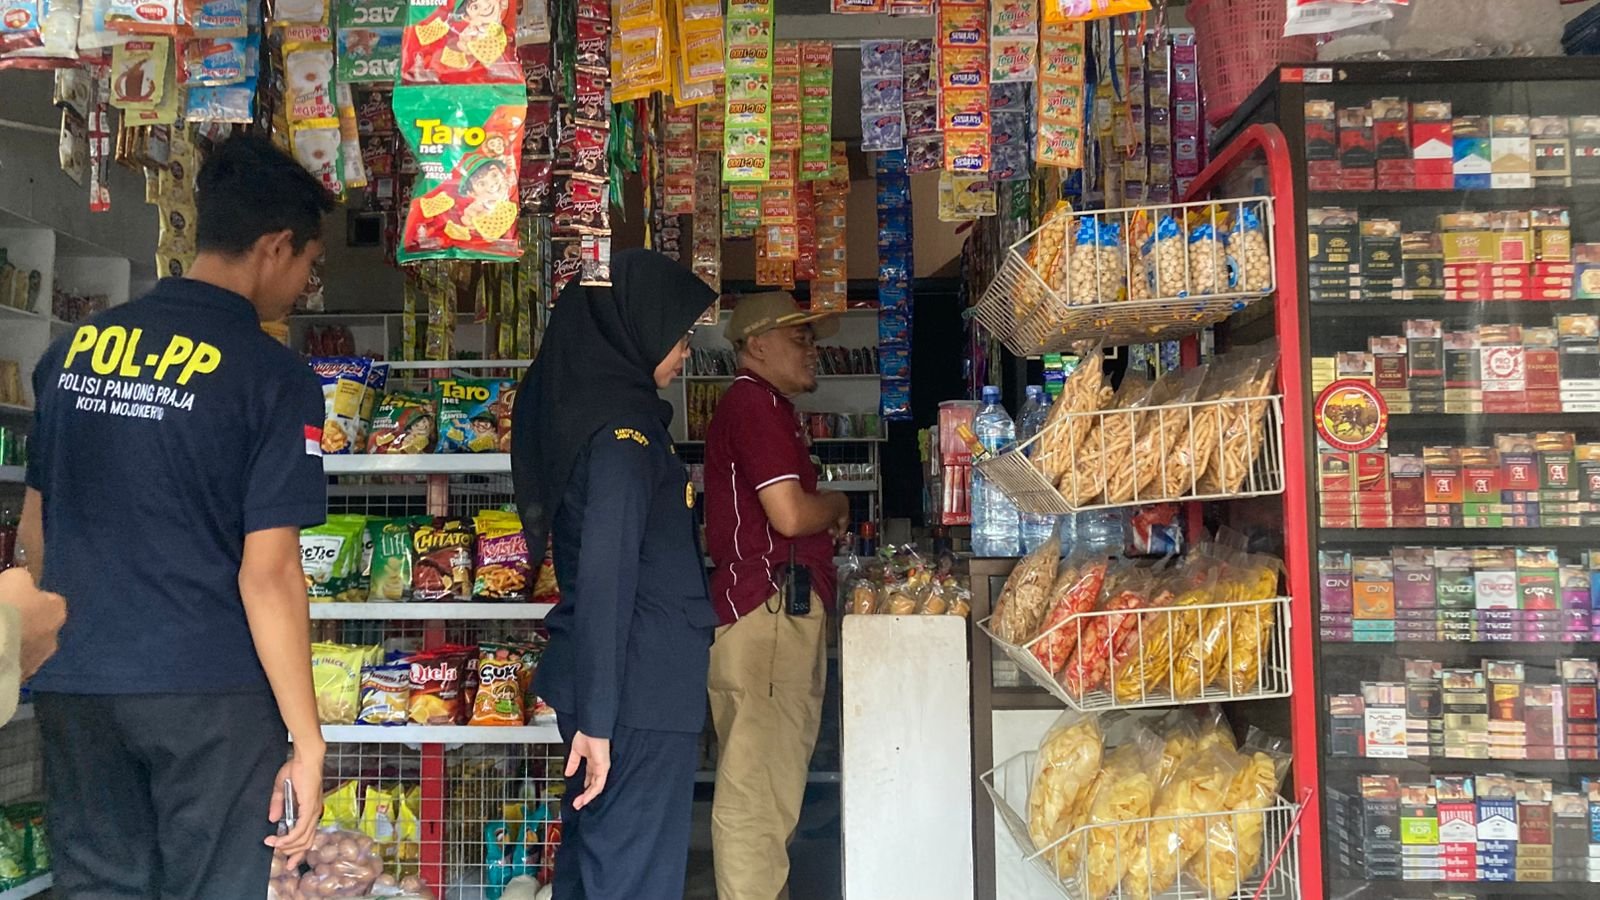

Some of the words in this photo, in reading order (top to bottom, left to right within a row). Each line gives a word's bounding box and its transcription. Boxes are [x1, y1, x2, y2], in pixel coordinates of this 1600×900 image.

[354, 6, 399, 23] ABC
[287, 29, 304, 41] Day
[305, 27, 330, 41] Good
[353, 58, 398, 77] ABC
[292, 104, 309, 116] Day
[309, 102, 335, 116] Good
[416, 119, 487, 147] Taro
[419, 145, 444, 154] net
[64, 325, 222, 385] POL-PP
[58, 373, 102, 394] POLISI
[104, 379, 153, 402] PAMONG
[156, 386, 195, 411] PRAJA
[438, 381, 490, 404] Taro
[76, 396, 106, 413] KOTA
[442, 397, 459, 405] net
[414, 529, 471, 552] CHITATO
[1524, 586, 1553, 595] CAMEL
[410, 662, 457, 684] Qtela
